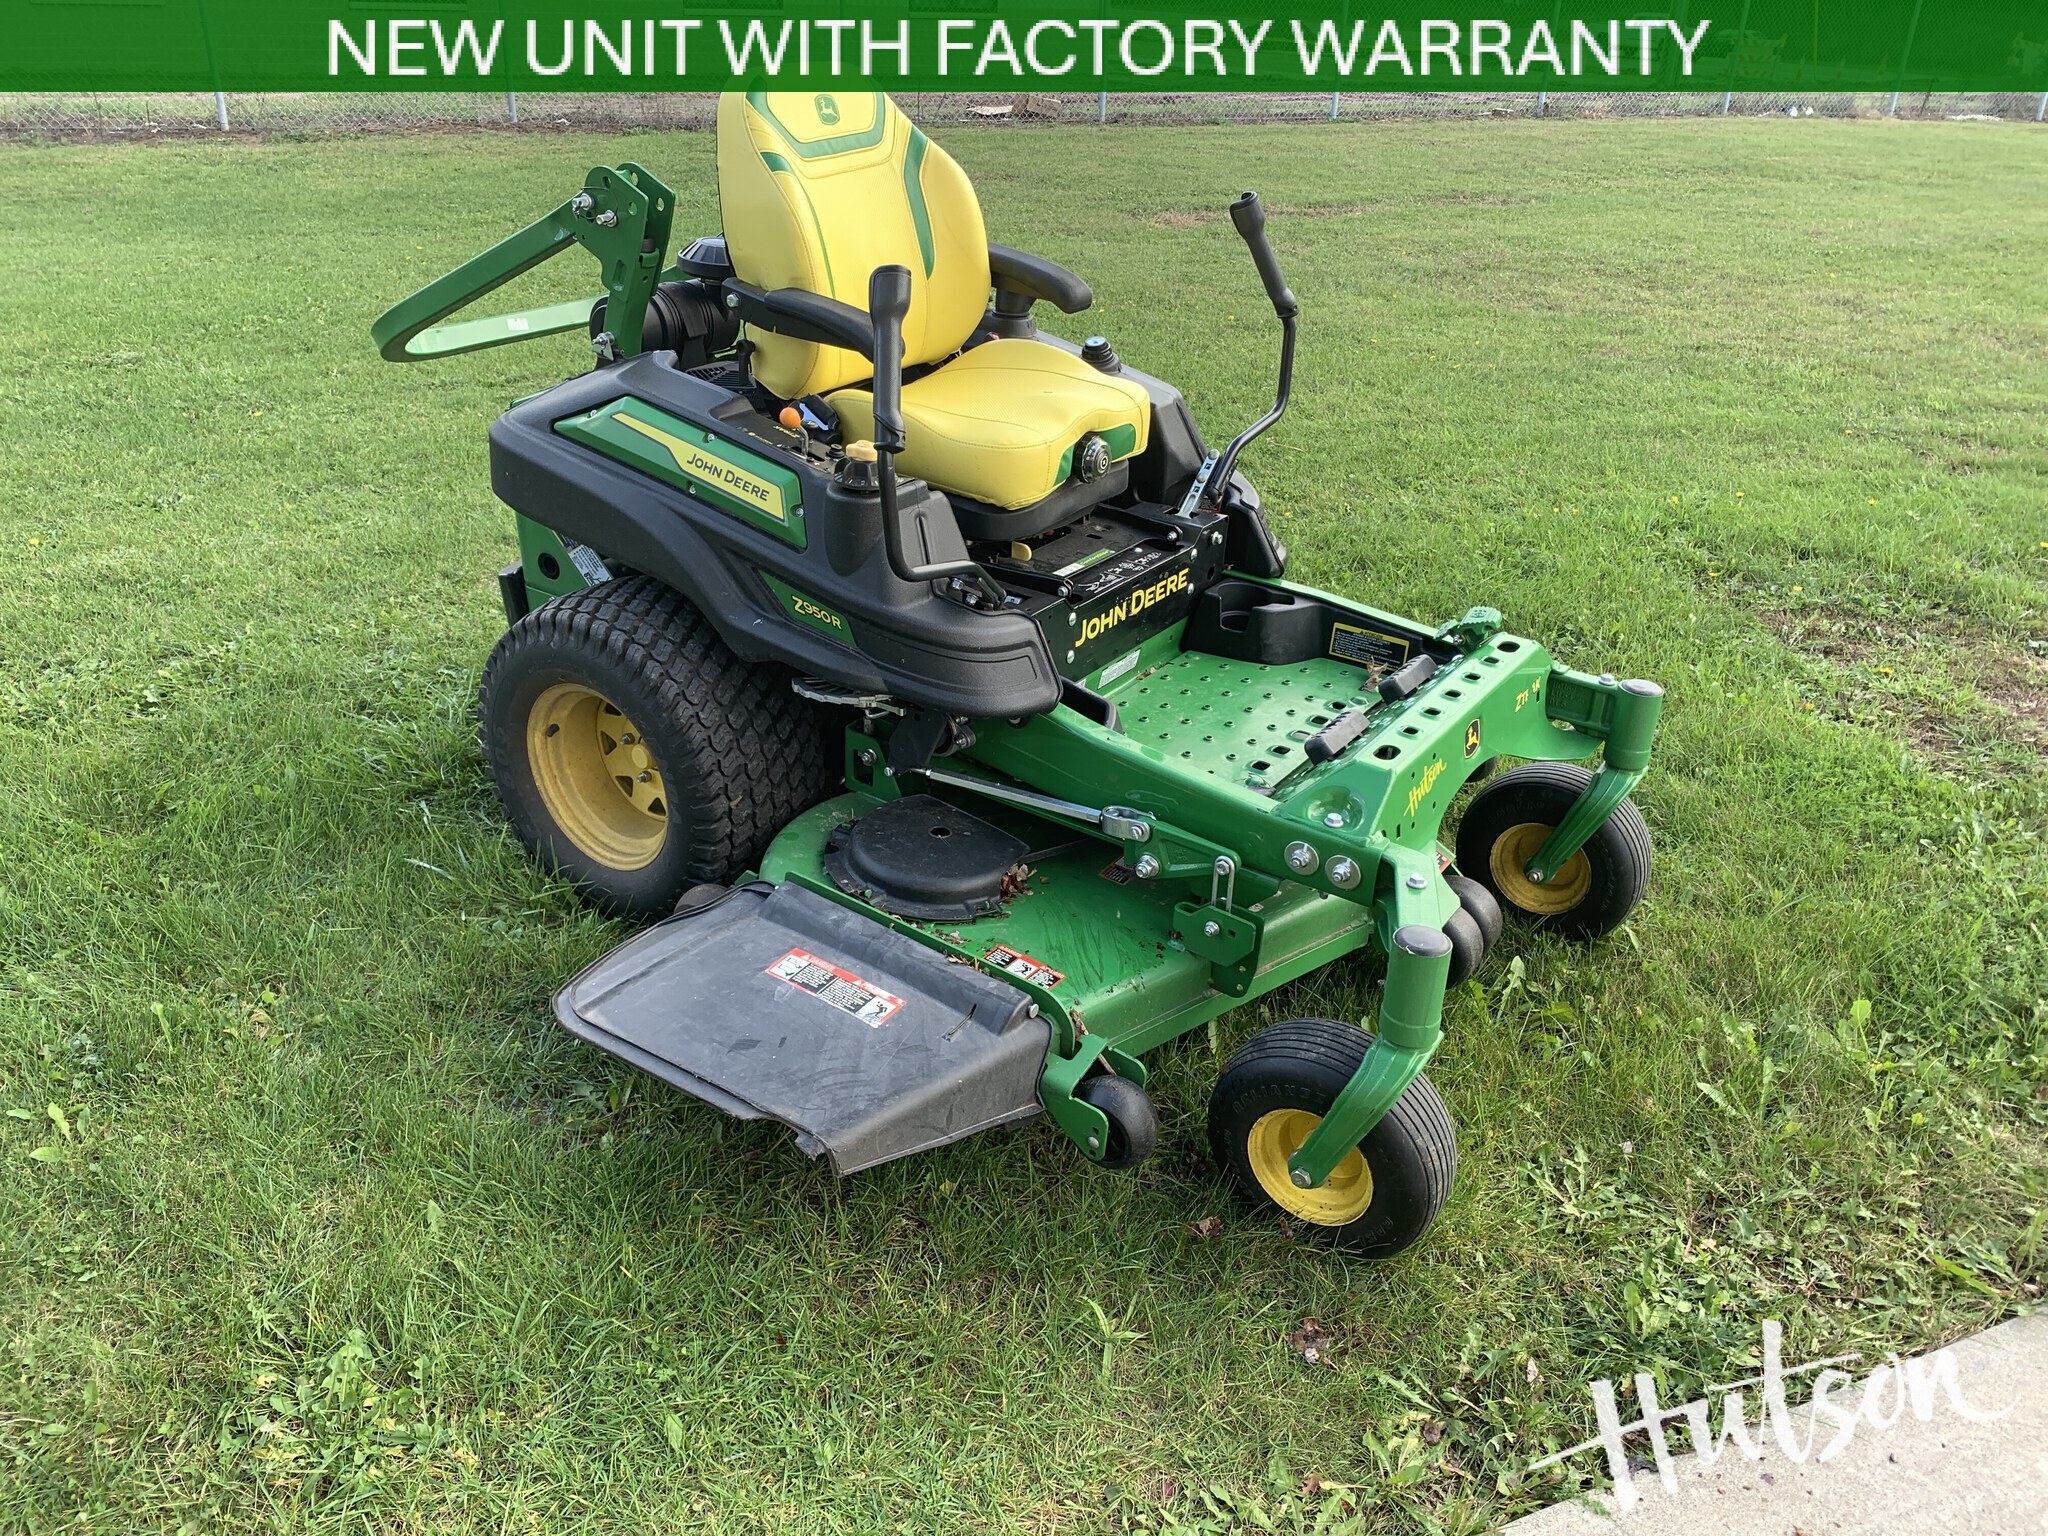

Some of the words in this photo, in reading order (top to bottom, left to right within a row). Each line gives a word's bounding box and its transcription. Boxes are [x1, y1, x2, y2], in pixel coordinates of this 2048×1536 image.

[686, 452, 724, 480] JOHN
[724, 469, 770, 502] DEERE
[790, 594, 843, 630] Z950R
[1074, 602, 1129, 648] JOHN
[1129, 567, 1190, 616] DEERE
[1403, 757, 1448, 818] Hutson
